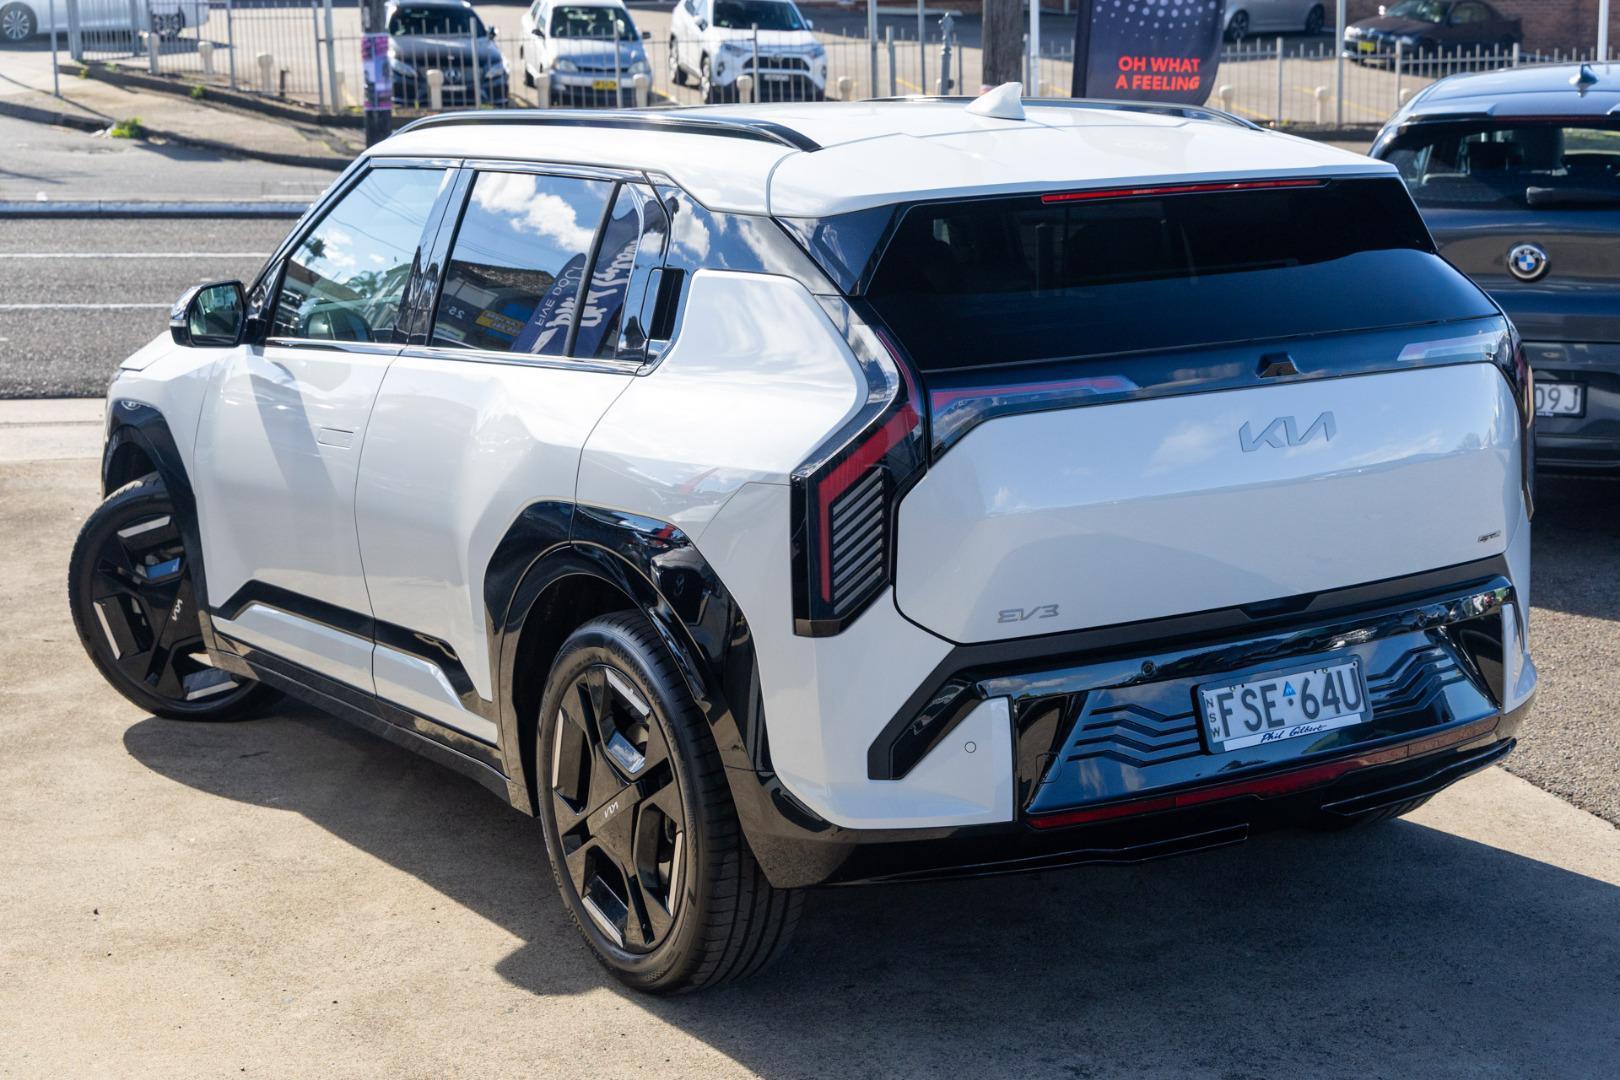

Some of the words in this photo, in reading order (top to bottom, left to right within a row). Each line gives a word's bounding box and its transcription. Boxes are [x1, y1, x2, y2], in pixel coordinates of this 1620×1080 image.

[1118, 55, 1147, 71] OH
[1150, 57, 1200, 72] WHAT
[1115, 74, 1128, 90] A
[1132, 75, 1200, 91] FEELING
[1238, 411, 1336, 452] KIA
[997, 604, 1060, 623] EV3
[1216, 683, 1285, 738] FSE
[1300, 667, 1362, 720] 64U
[1260, 732, 1285, 743] Phil
[1288, 724, 1327, 737] Gilbert
